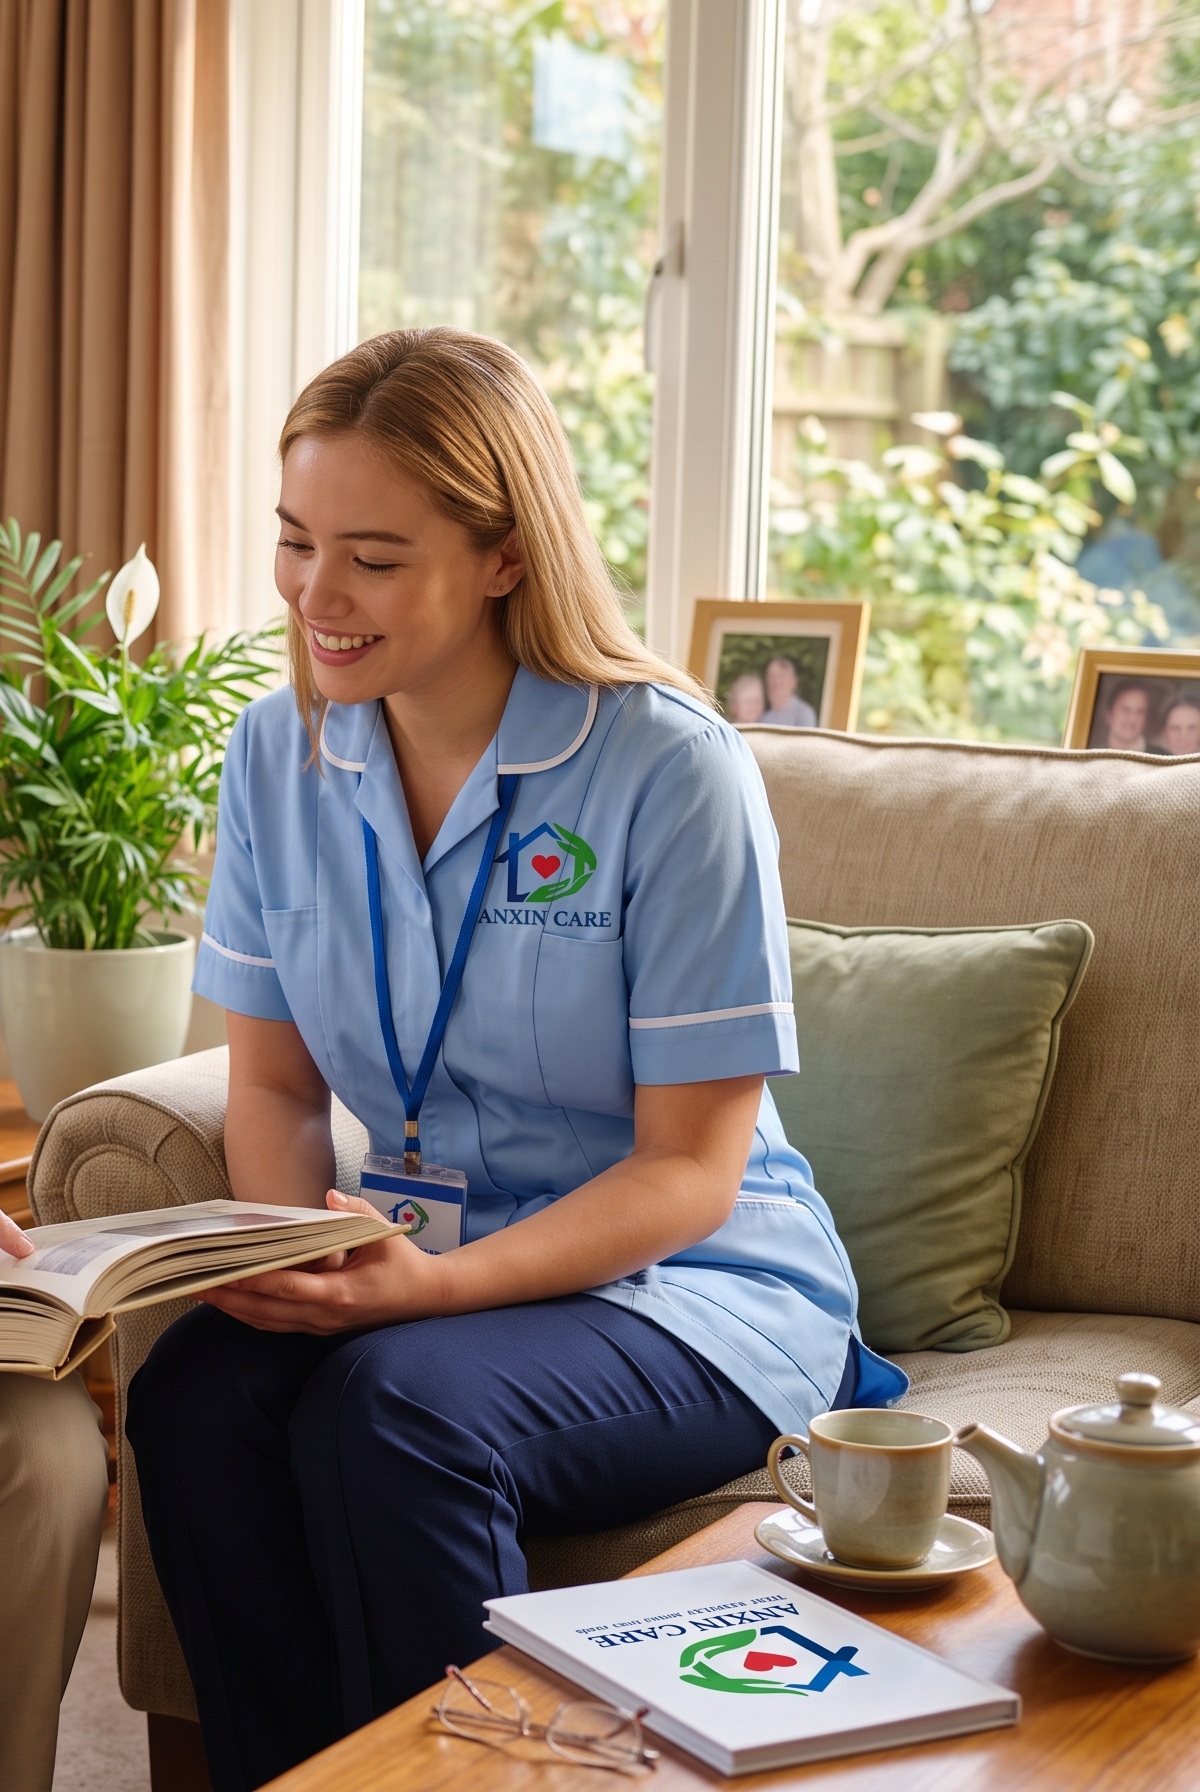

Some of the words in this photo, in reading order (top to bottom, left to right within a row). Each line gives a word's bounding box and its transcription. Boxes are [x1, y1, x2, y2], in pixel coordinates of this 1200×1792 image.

[478, 909, 548, 926] ANXIN
[554, 911, 612, 928] CARE
[688, 1603, 800, 1632] ANXIN
[588, 1624, 687, 1648] CARE
